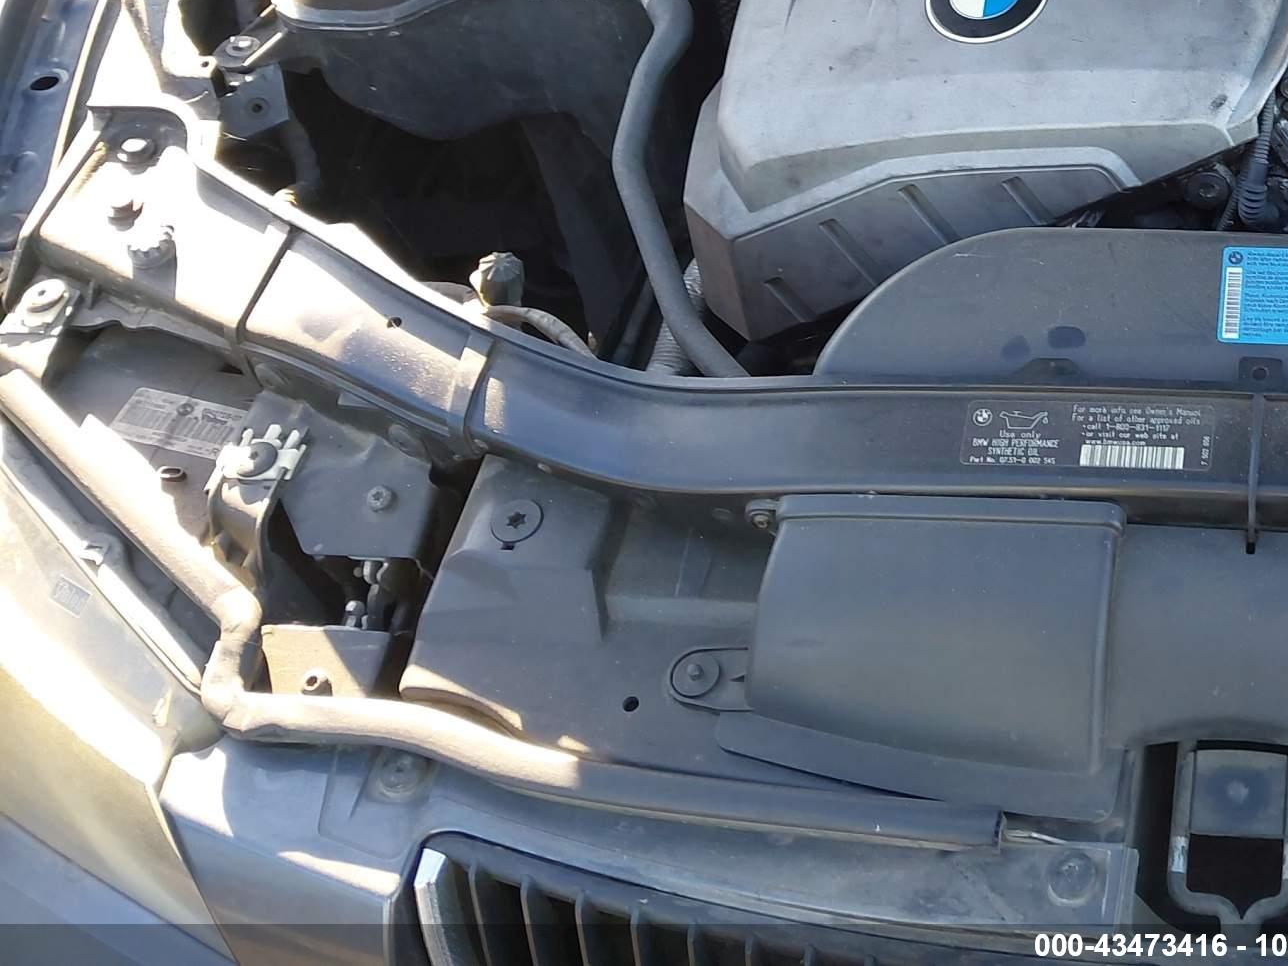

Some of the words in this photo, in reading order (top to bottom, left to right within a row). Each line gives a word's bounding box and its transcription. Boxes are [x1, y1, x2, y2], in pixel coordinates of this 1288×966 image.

[1073, 404, 1086, 413] For
[1072, 413, 1085, 421] For
[1097, 414, 1110, 422] list
[1114, 415, 1124, 423] of
[1126, 415, 1146, 423] other
[1150, 416, 1183, 425] approved
[999, 430, 1016, 438] Use
[1020, 430, 1042, 439] only
[1152, 432, 1168, 440] site
[972, 437, 989, 447] BMW
[991, 438, 1009, 447] HIGH
[1011, 439, 1060, 448] PERFORMANCE
[988, 447, 1025, 455] SYNTHETIC
[1028, 448, 1040, 456] OIL
